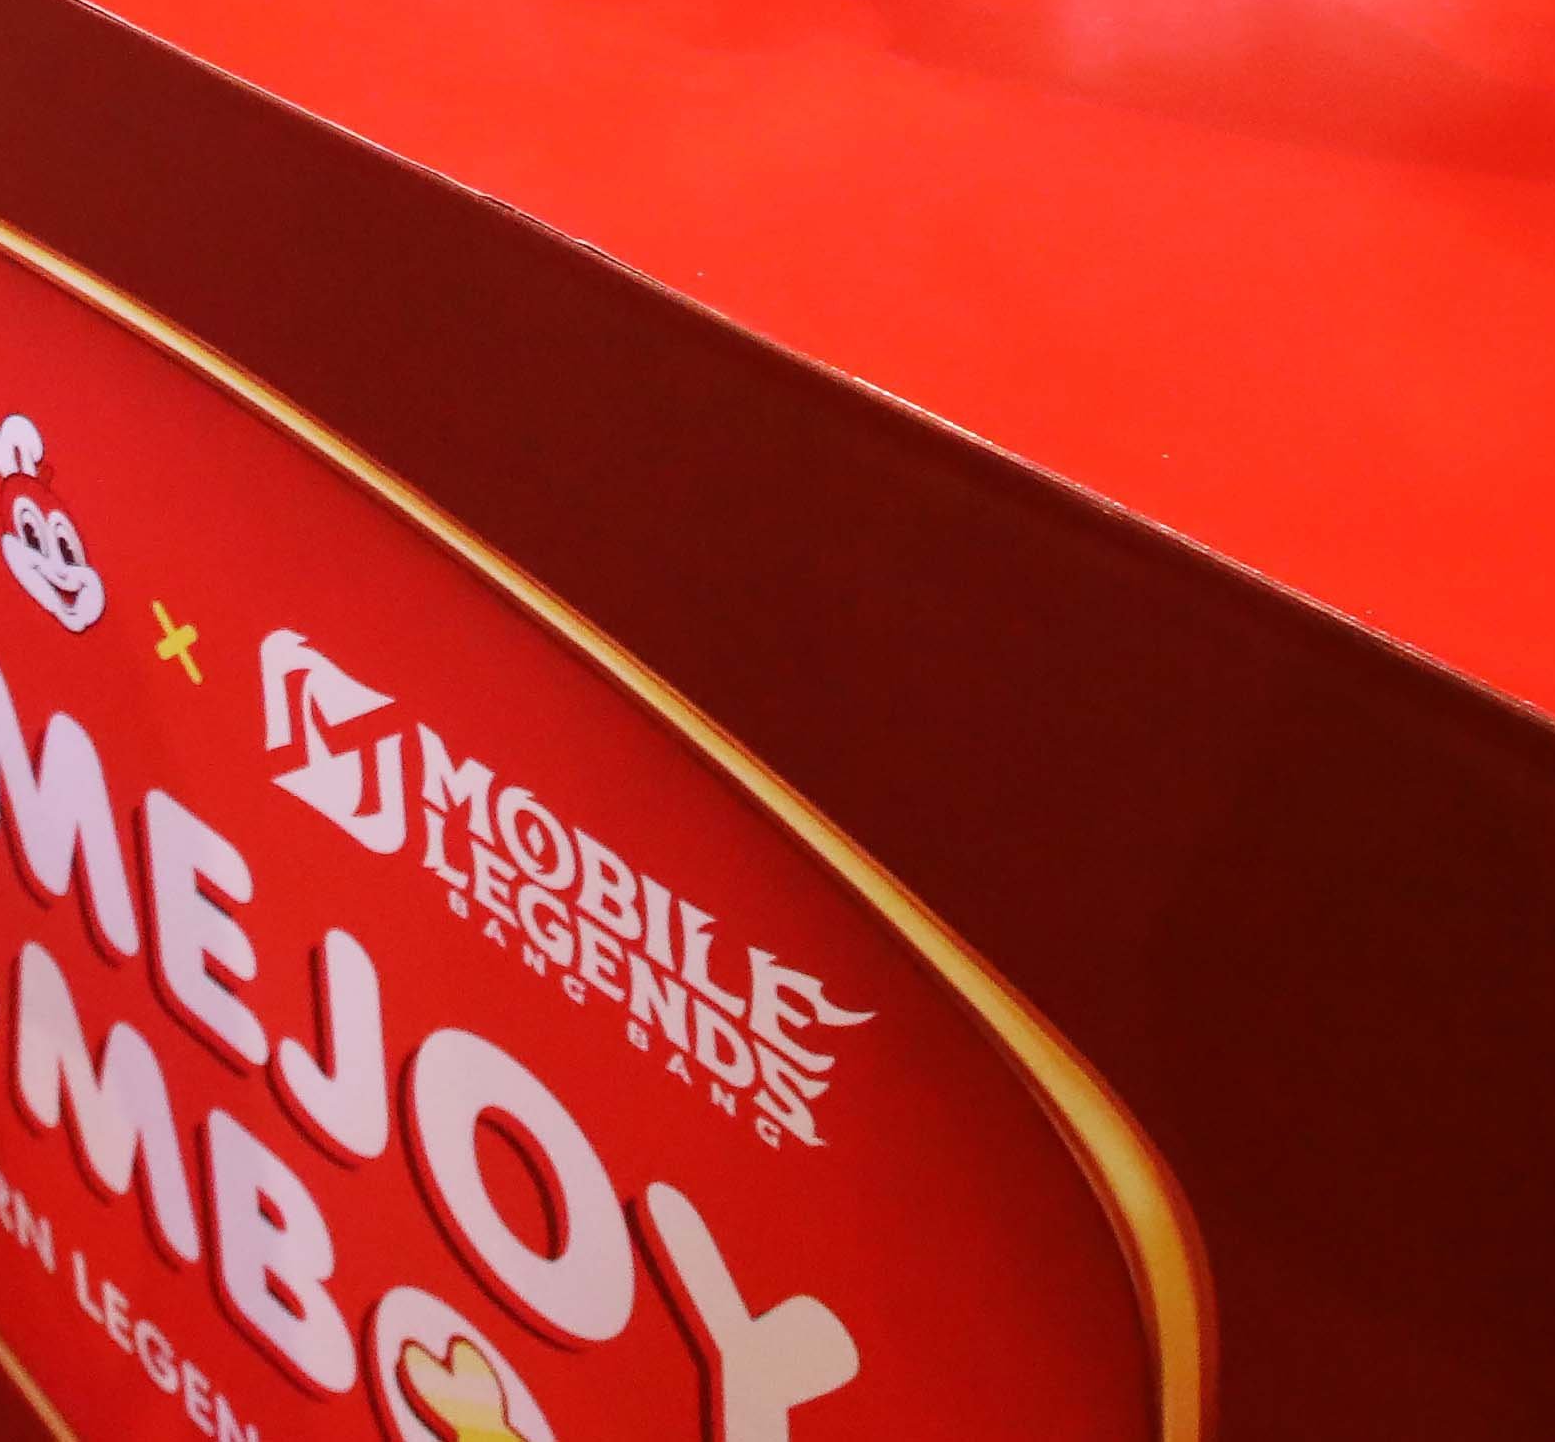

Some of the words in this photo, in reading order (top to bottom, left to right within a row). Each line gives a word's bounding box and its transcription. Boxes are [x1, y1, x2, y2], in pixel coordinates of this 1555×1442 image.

[418, 722, 878, 1072] MOBILE
[422, 808, 829, 1147] LEGENDS
[448, 890, 586, 1005] BANG
[626, 1020, 782, 1150] BANG
